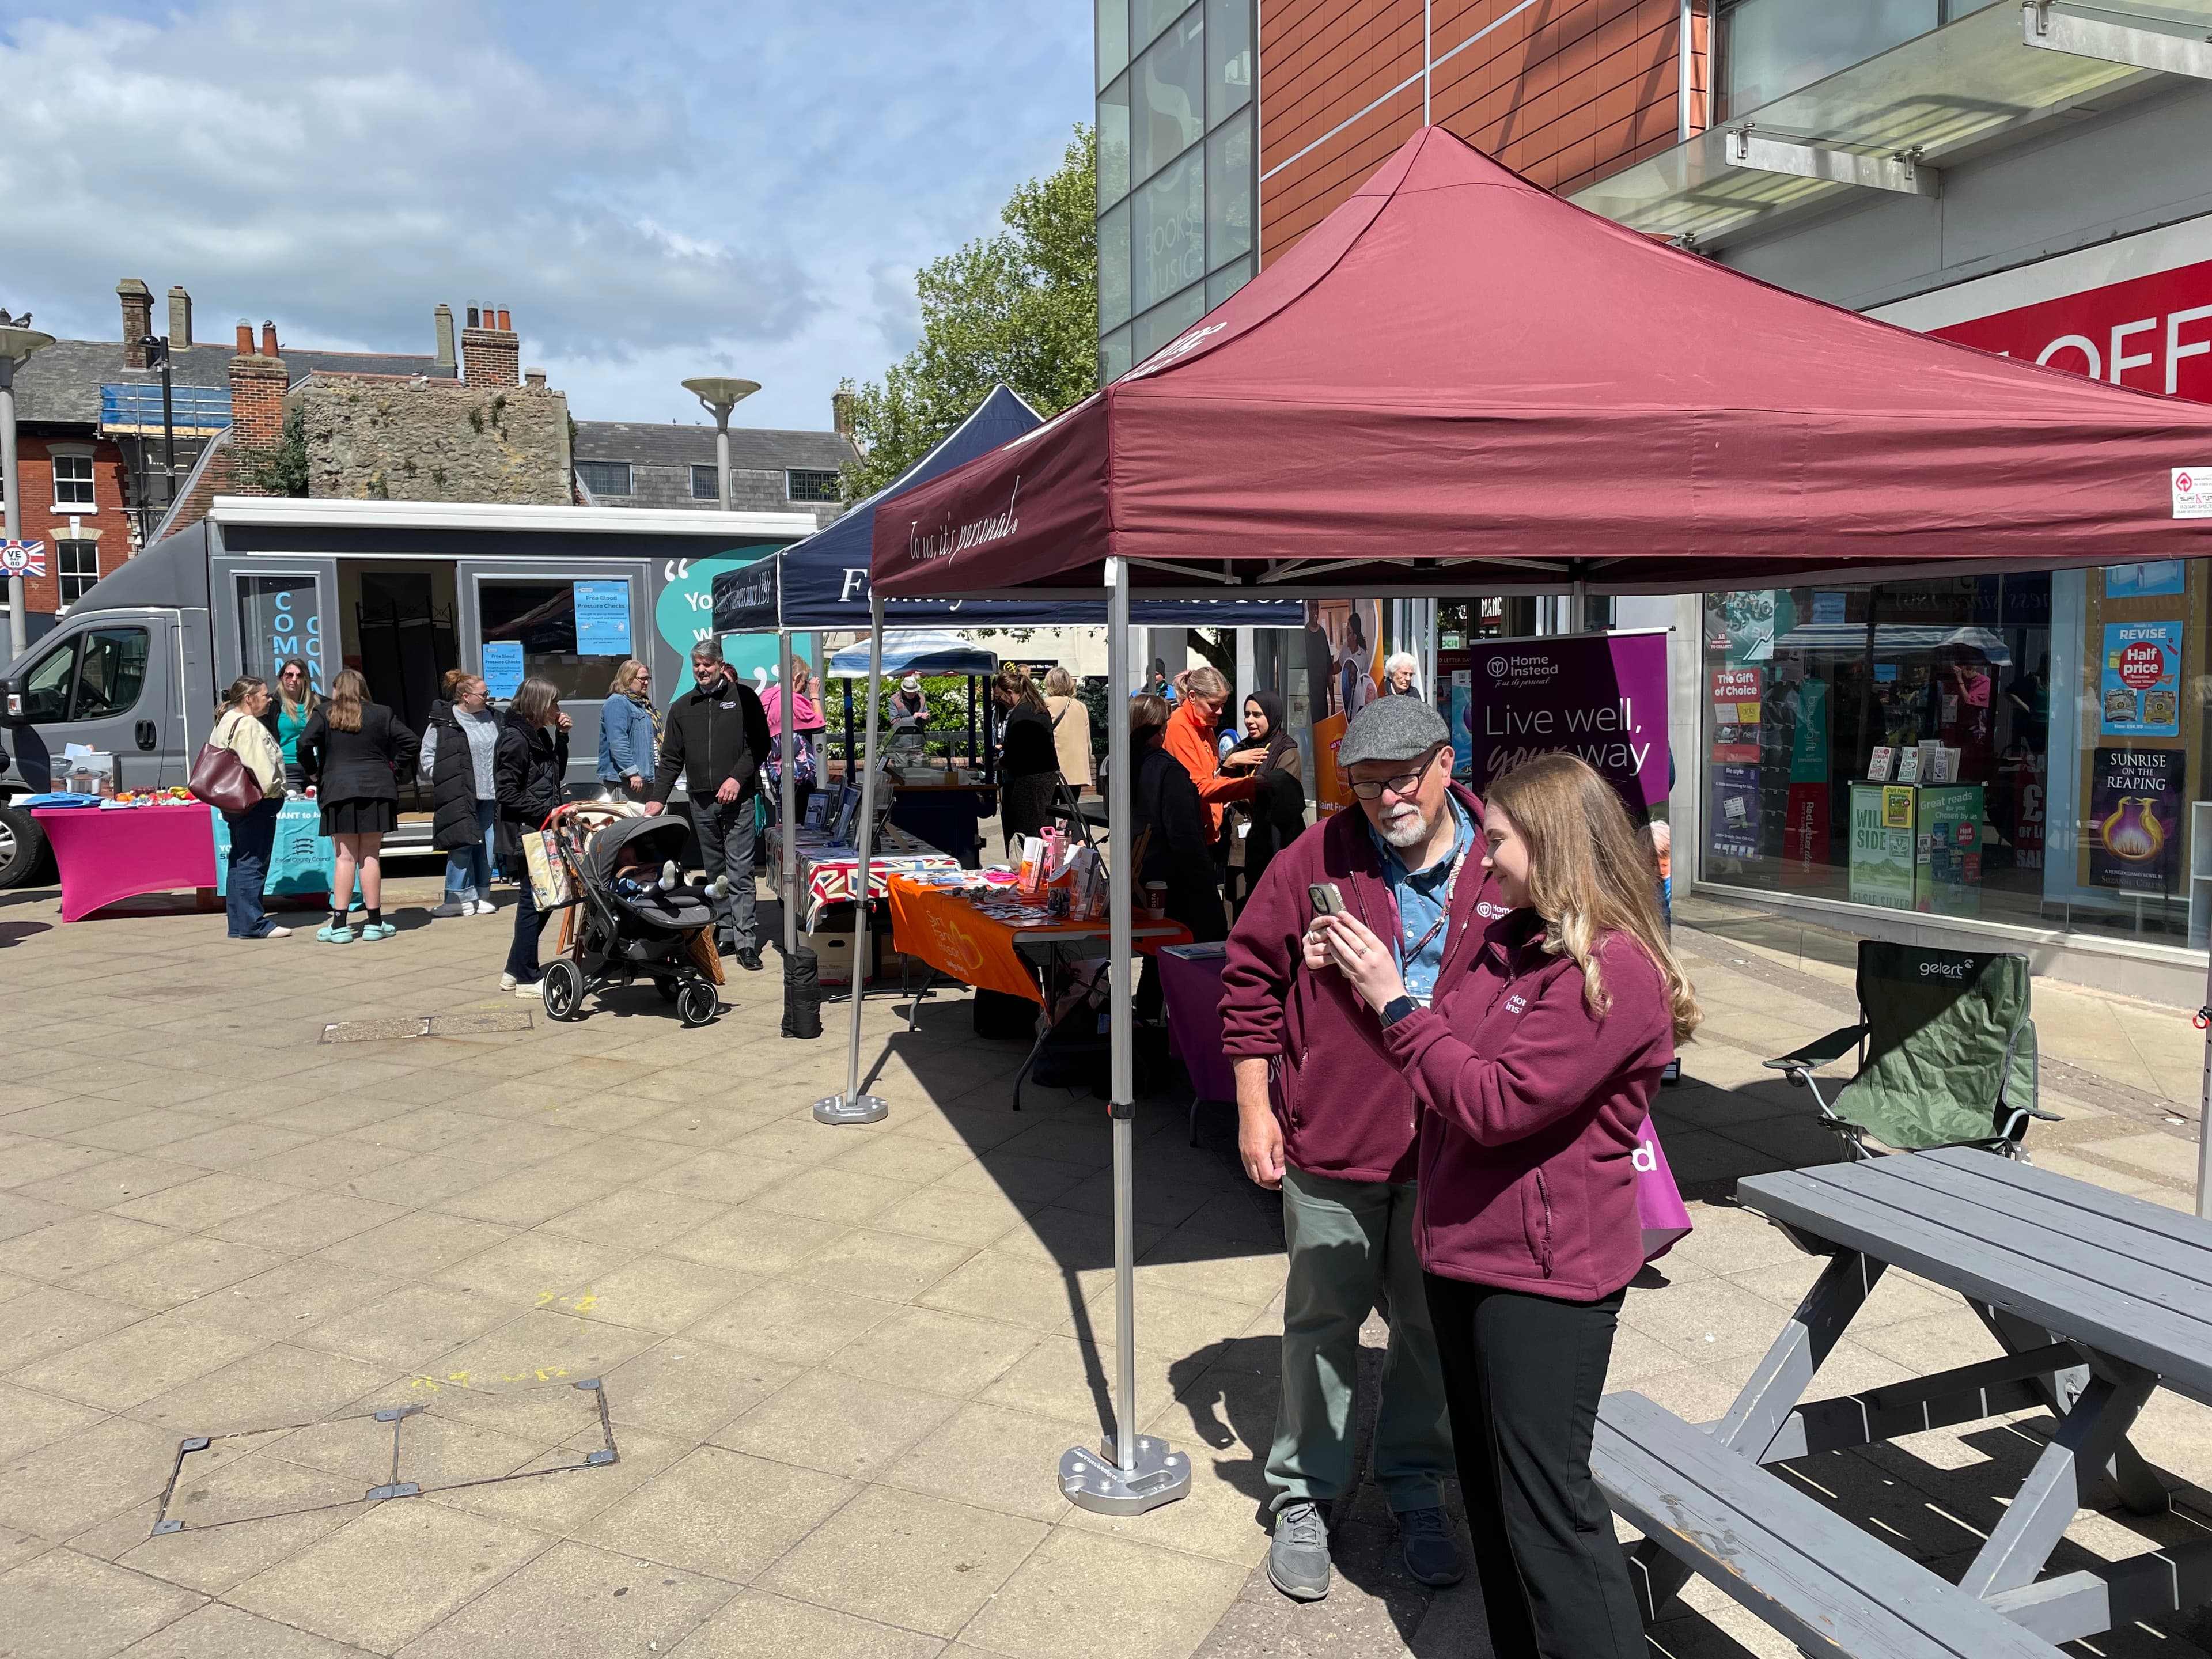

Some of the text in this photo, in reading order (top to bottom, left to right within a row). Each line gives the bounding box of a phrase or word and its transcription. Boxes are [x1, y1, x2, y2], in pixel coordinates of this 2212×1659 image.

[1145, 206, 1194, 262] BOOKS
[1146, 248, 1194, 302] MUSIC
[910, 521, 919, 559] To
[2119, 628, 2166, 639] REVISE
[2127, 648, 2157, 660] Half
[1510, 656, 1548, 666] Home
[1510, 664, 1558, 676] Instead
[2123, 662, 2159, 676] price
[1717, 672, 1754, 684] The Gift
[1714, 685, 1758, 696] of Choice
[1486, 697, 1641, 736] Live well,
[1577, 742, 1650, 777] way
[2110, 753, 2166, 767] SUNRISE
[2122, 767, 2153, 776] ON THE
[2107, 776, 2166, 791] REAPING
[1318, 800, 1333, 809] Saint
[1920, 791, 1973, 810] Great reads
[2022, 783, 2043, 823] £
[1935, 811, 1959, 820] Chosen
[1960, 812, 1968, 821] by
[2019, 826, 2031, 838] or
[1857, 830, 1886, 851] SIDE
[2101, 875, 2132, 885] SUZANNE
[1880, 896, 1910, 909] SILVER
[1919, 961, 1963, 976] gelert
